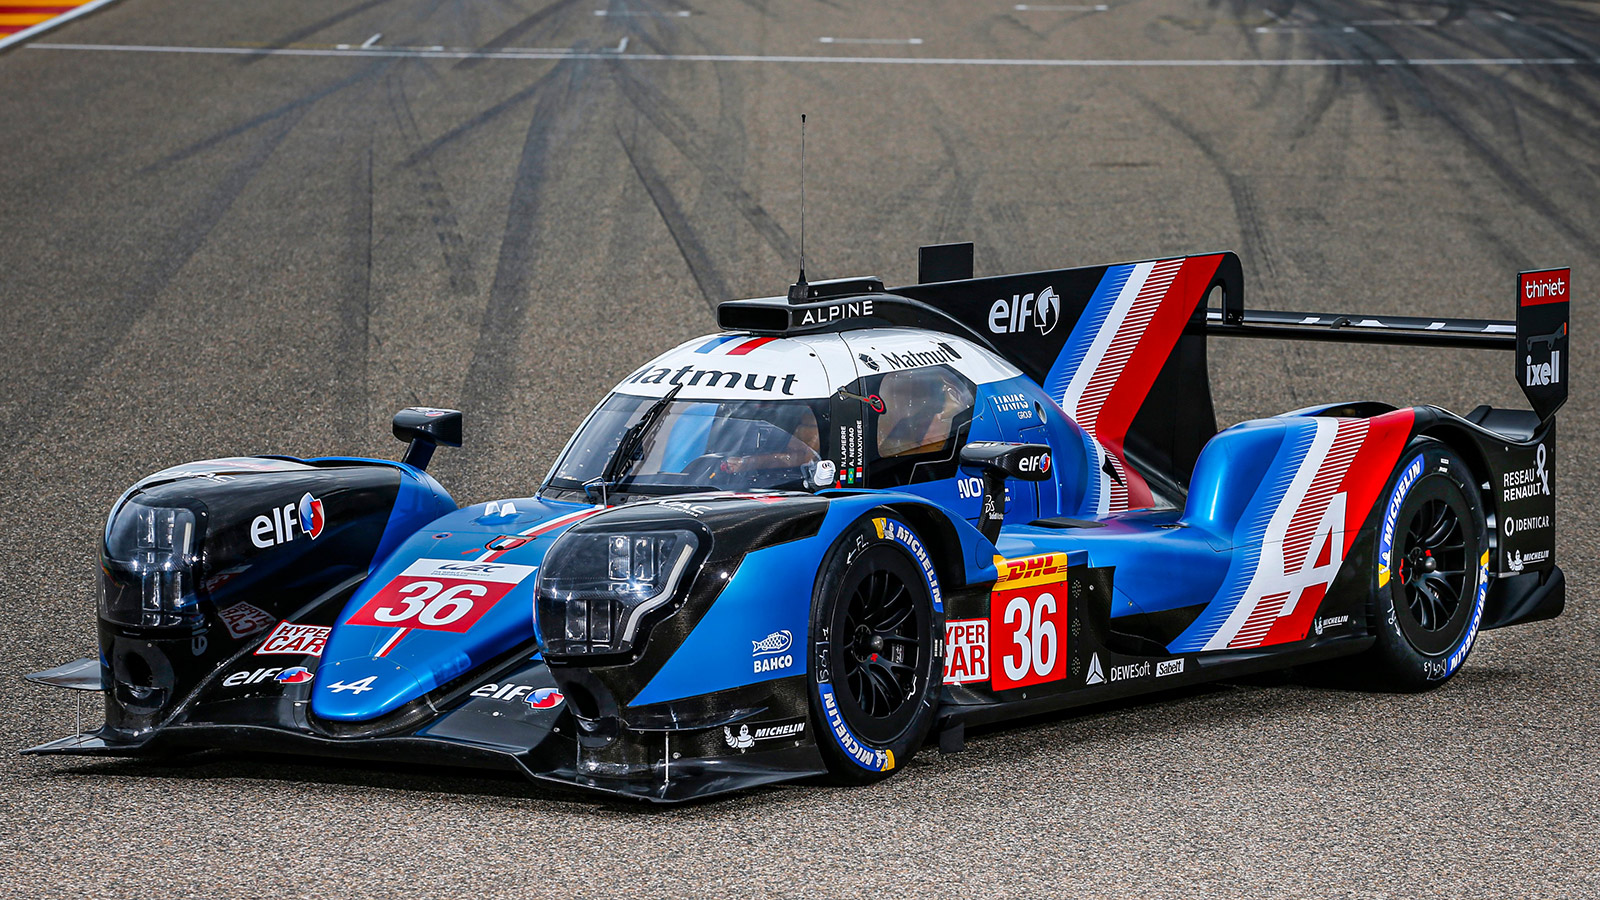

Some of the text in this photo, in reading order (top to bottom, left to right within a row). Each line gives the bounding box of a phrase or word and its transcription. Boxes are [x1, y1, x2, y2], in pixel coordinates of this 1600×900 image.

[1525, 277, 1566, 299] thiriet
[801, 299, 874, 326] ALPINE
[988, 293, 1035, 334] elf
[881, 346, 955, 370] Matmut
[1526, 350, 1560, 387] ixell
[1018, 455, 1040, 472] elf
[1503, 467, 1535, 488] RESEAU
[1383, 459, 1422, 550] MICHELIN
[1503, 482, 1542, 502] RENAULT
[250, 502, 298, 549] elf
[1515, 515, 1550, 532] IDENTICAR
[896, 525, 942, 604] MICHELIN
[1006, 555, 1059, 582] DHL
[373, 580, 489, 626] 36
[945, 624, 986, 646] YPER
[1002, 592, 1058, 682] 36
[1450, 587, 1486, 673] MICHELIN
[753, 654, 793, 673] BAHCO
[943, 645, 987, 678] AR
[1110, 661, 1151, 682] DEWESoft
[222, 667, 283, 687] elf
[469, 683, 533, 702] elf
[754, 722, 806, 738] MICHELIN
[823, 691, 874, 767] MICHELIN
